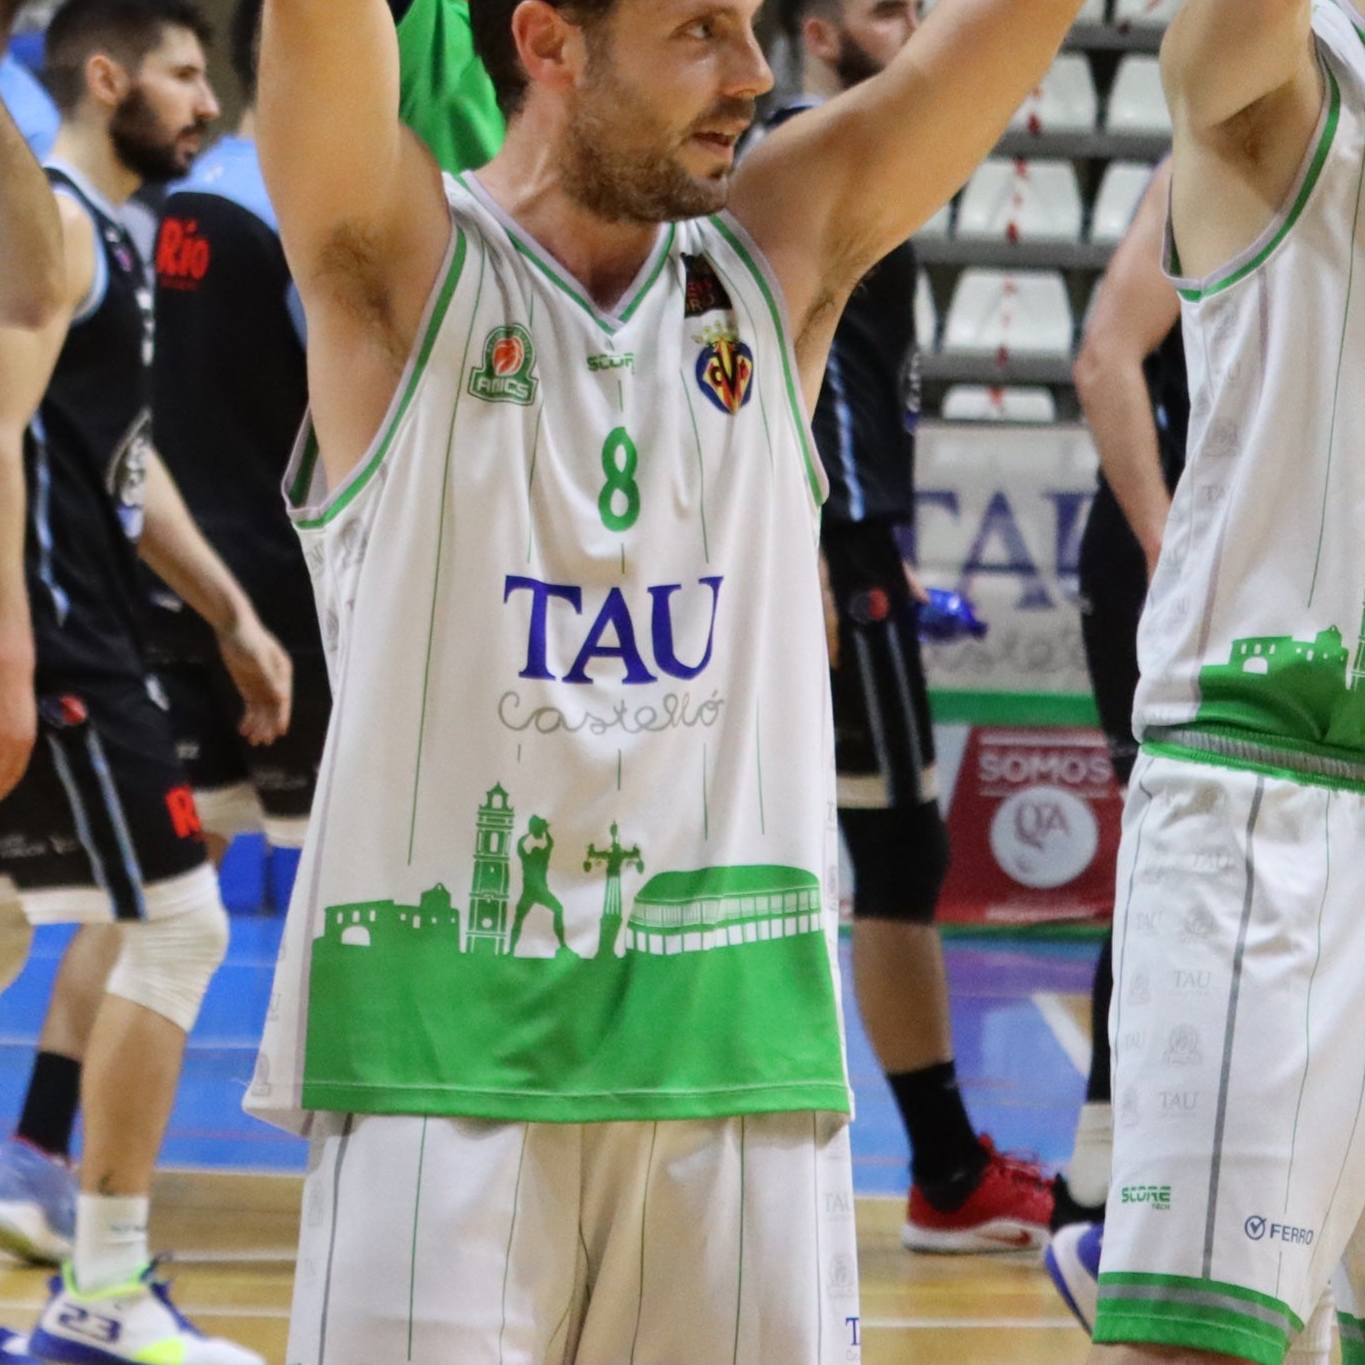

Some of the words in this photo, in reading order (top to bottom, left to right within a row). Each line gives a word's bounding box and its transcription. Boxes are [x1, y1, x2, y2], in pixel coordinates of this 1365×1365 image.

[598, 426, 640, 532] 8
[504, 575, 725, 685] TAU
[498, 690, 726, 737] Castelló
[979, 752, 1113, 784] SOMOS
[1173, 970, 1212, 989] TAU
[1159, 1091, 1199, 1111] TAU
[1121, 1185, 1171, 1204] SCORE
[1270, 1222, 1315, 1246] FERRO
